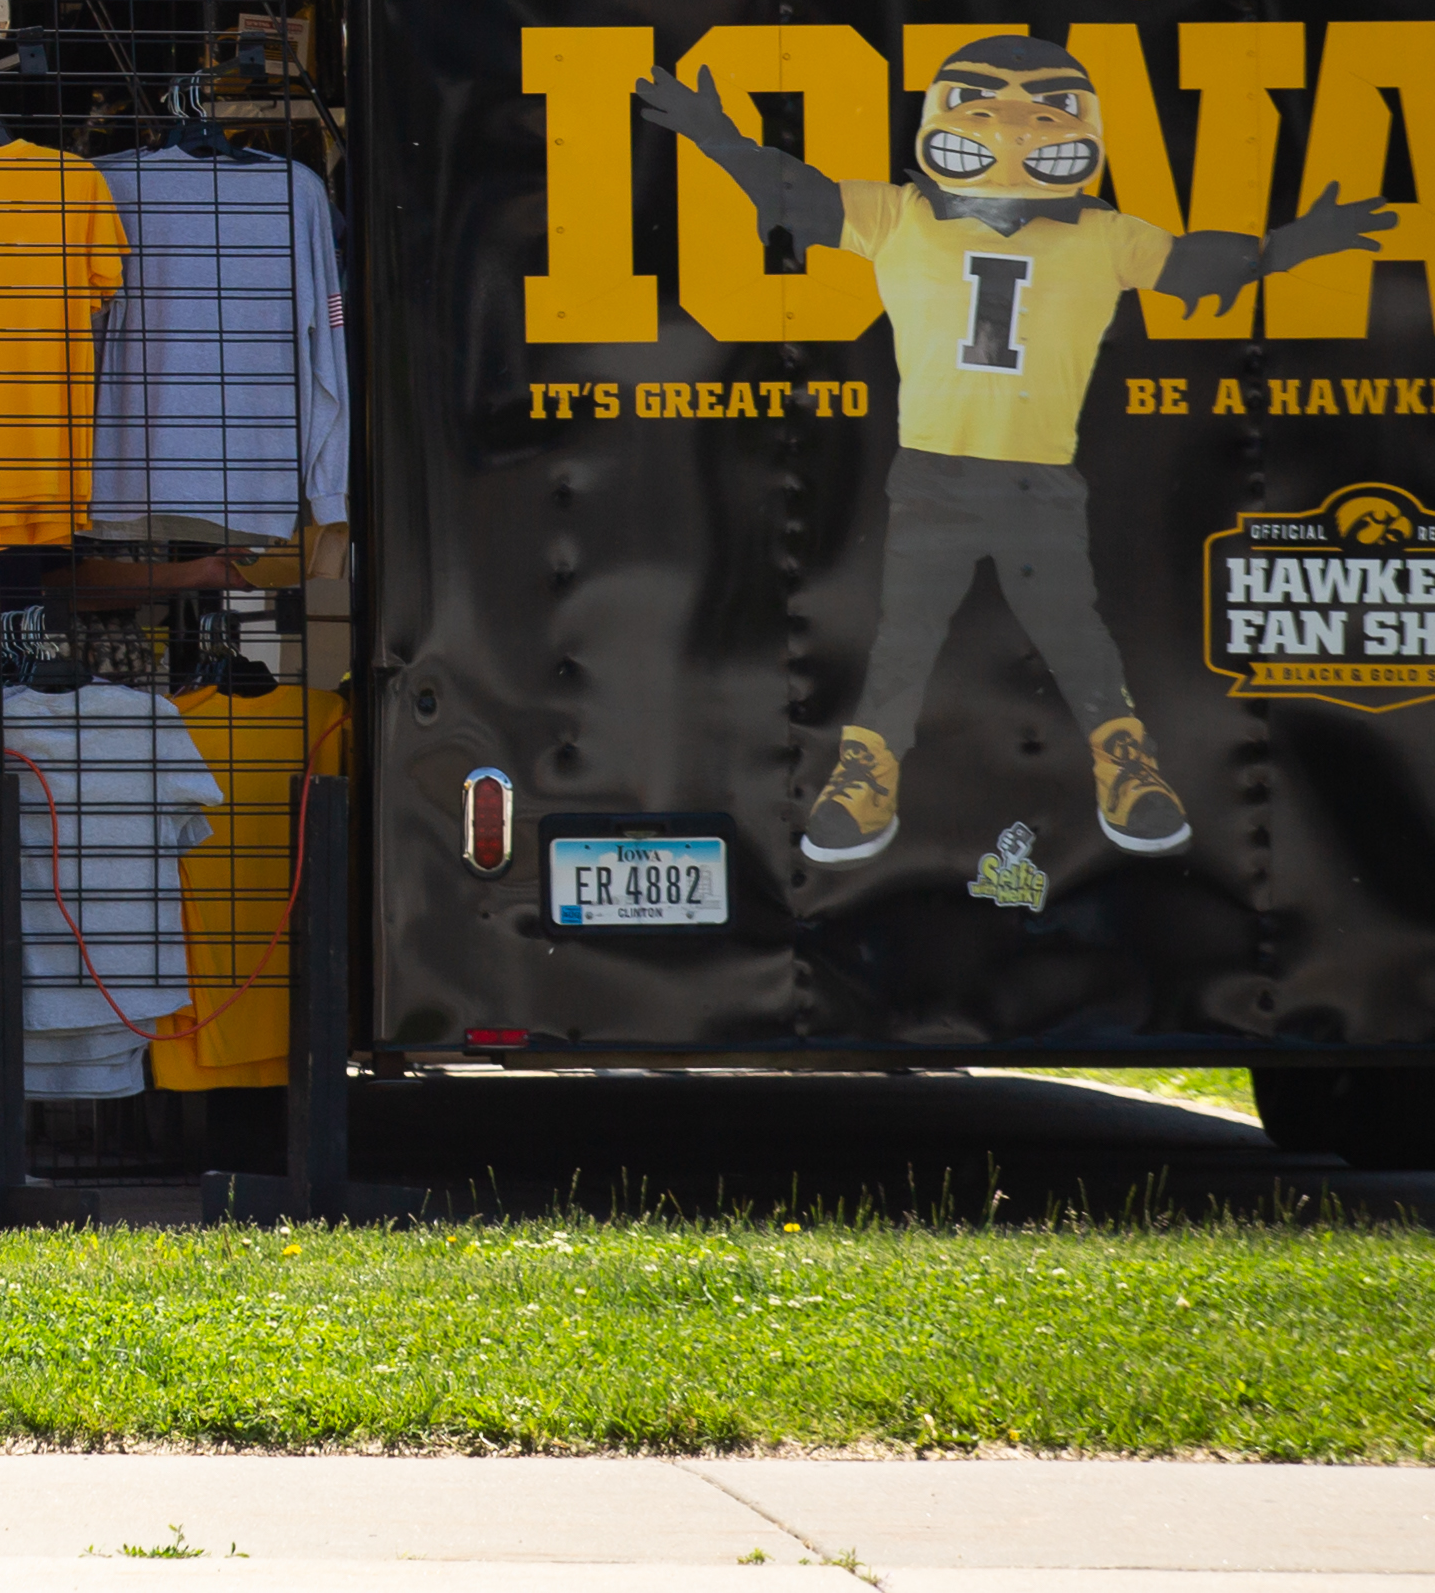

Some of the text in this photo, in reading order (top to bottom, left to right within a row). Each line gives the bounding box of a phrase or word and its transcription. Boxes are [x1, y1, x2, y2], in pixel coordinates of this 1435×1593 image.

[521, 22, 1435, 343] IOWA
[529, 377, 1435, 419] IT'S GREAT TO BE A HAWK
[1250, 524, 1328, 541] OFFICIAL
[1226, 609, 1348, 655] FAN
[1264, 667, 1276, 681] A
[1282, 667, 1344, 682] BLACK
[1370, 667, 1420, 682] GOLD
[575, 865, 701, 905] ER 4882
[981, 855, 1044, 890] Selfie
[618, 907, 664, 919] CLINTON
